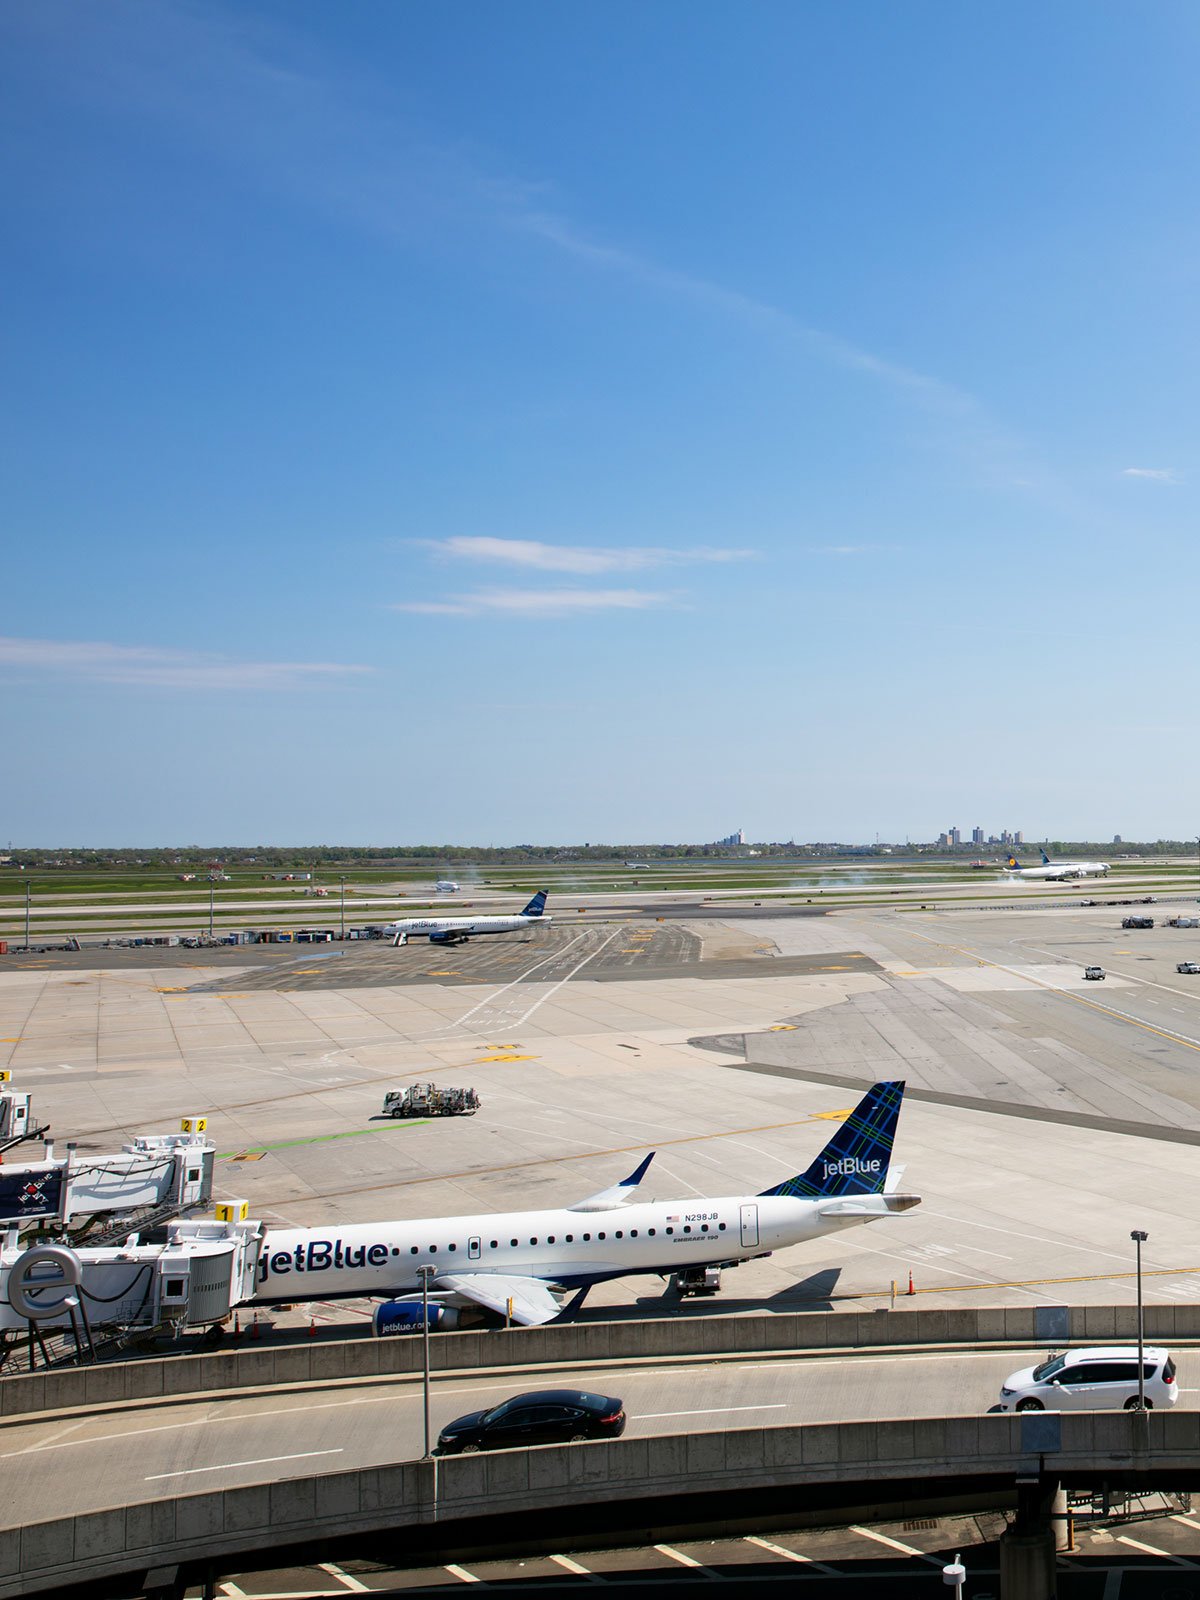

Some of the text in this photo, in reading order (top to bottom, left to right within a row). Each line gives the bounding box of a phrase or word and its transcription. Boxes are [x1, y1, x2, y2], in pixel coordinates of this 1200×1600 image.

[185, 1120, 190, 1132] 2
[199, 1120, 204, 1132] 2
[822, 1157, 881, 1180] jetBlue
[221, 1206, 229, 1220] 1
[241, 1206, 247, 1218] 1
[685, 1212, 719, 1222] N298JB
[258, 1239, 389, 1283] jetBlue
